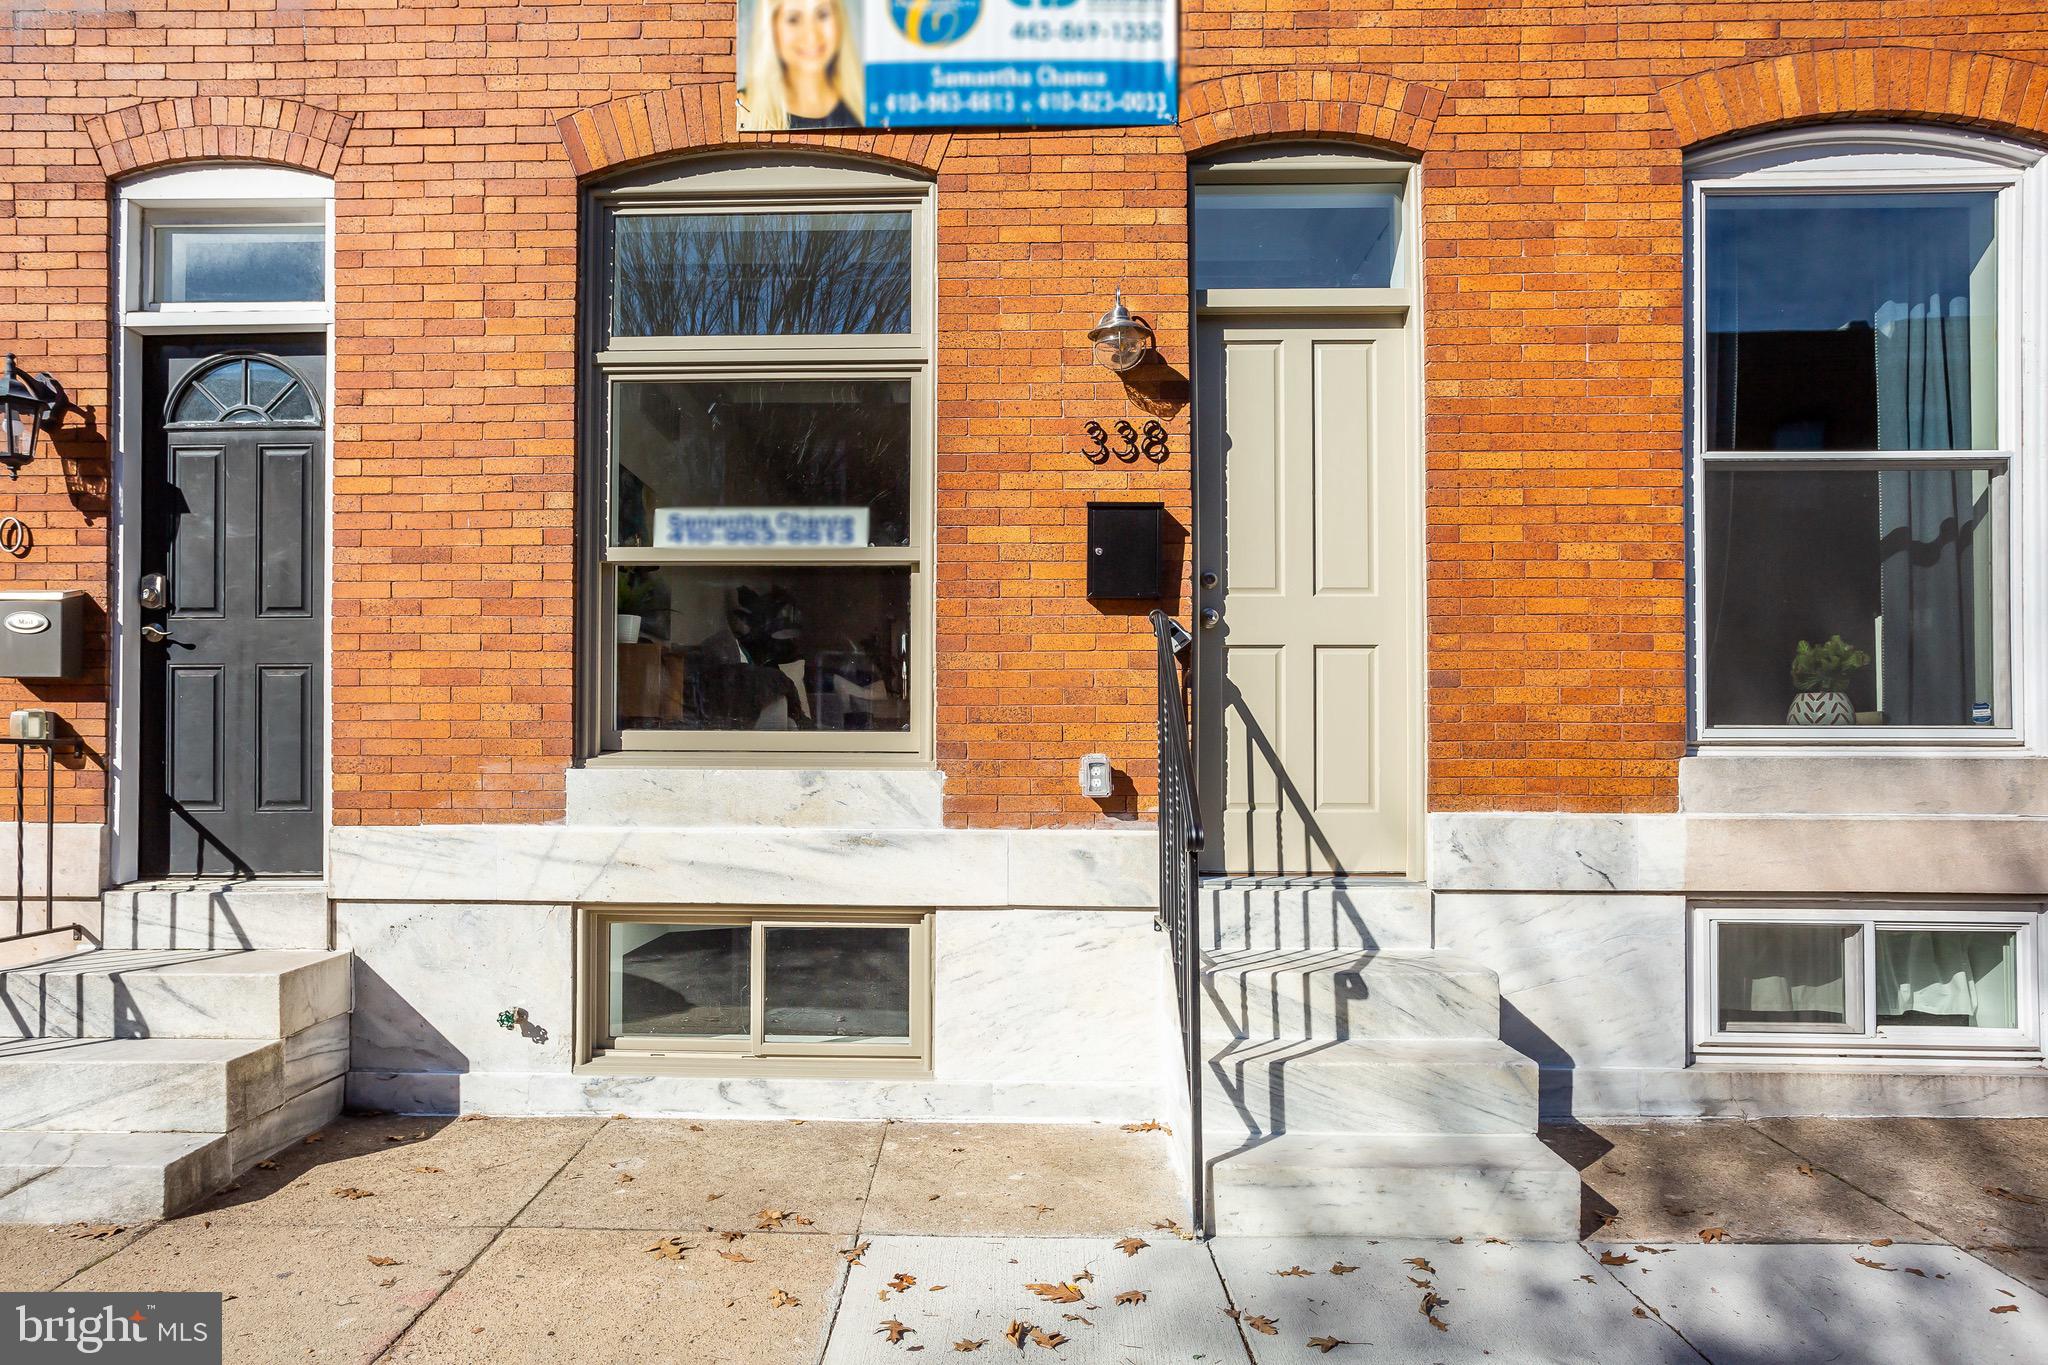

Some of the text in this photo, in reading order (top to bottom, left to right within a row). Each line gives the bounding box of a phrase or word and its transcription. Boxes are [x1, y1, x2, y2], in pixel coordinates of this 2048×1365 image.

[931, 65, 1031, 87] Samantha
[1082, 420, 1165, 458] 338
[667, 512, 770, 530] Samantha
